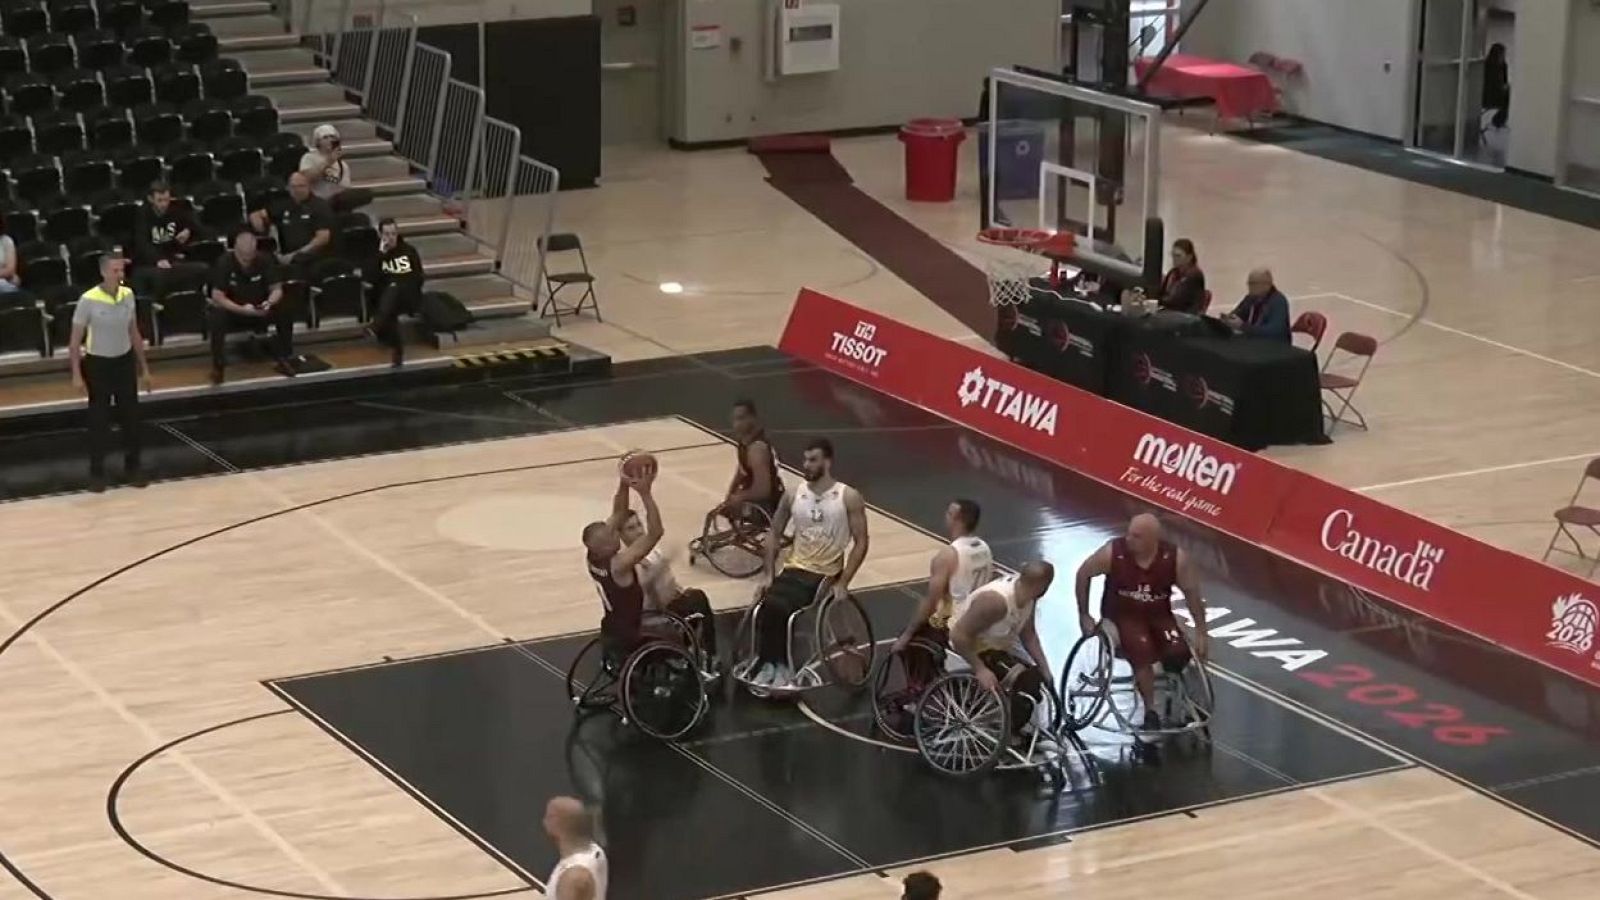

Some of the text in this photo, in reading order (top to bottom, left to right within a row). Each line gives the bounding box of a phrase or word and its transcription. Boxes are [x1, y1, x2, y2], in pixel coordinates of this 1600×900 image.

[382, 255, 411, 274] AUS
[831, 331, 888, 367] TISSOT
[957, 366, 1058, 436] OTTAWA
[1119, 466, 1223, 517] For the real game
[1133, 433, 1236, 495] molten
[1321, 509, 1436, 592] Canada
[1545, 619, 1595, 652] 2026
[1296, 663, 1514, 746] 2026
